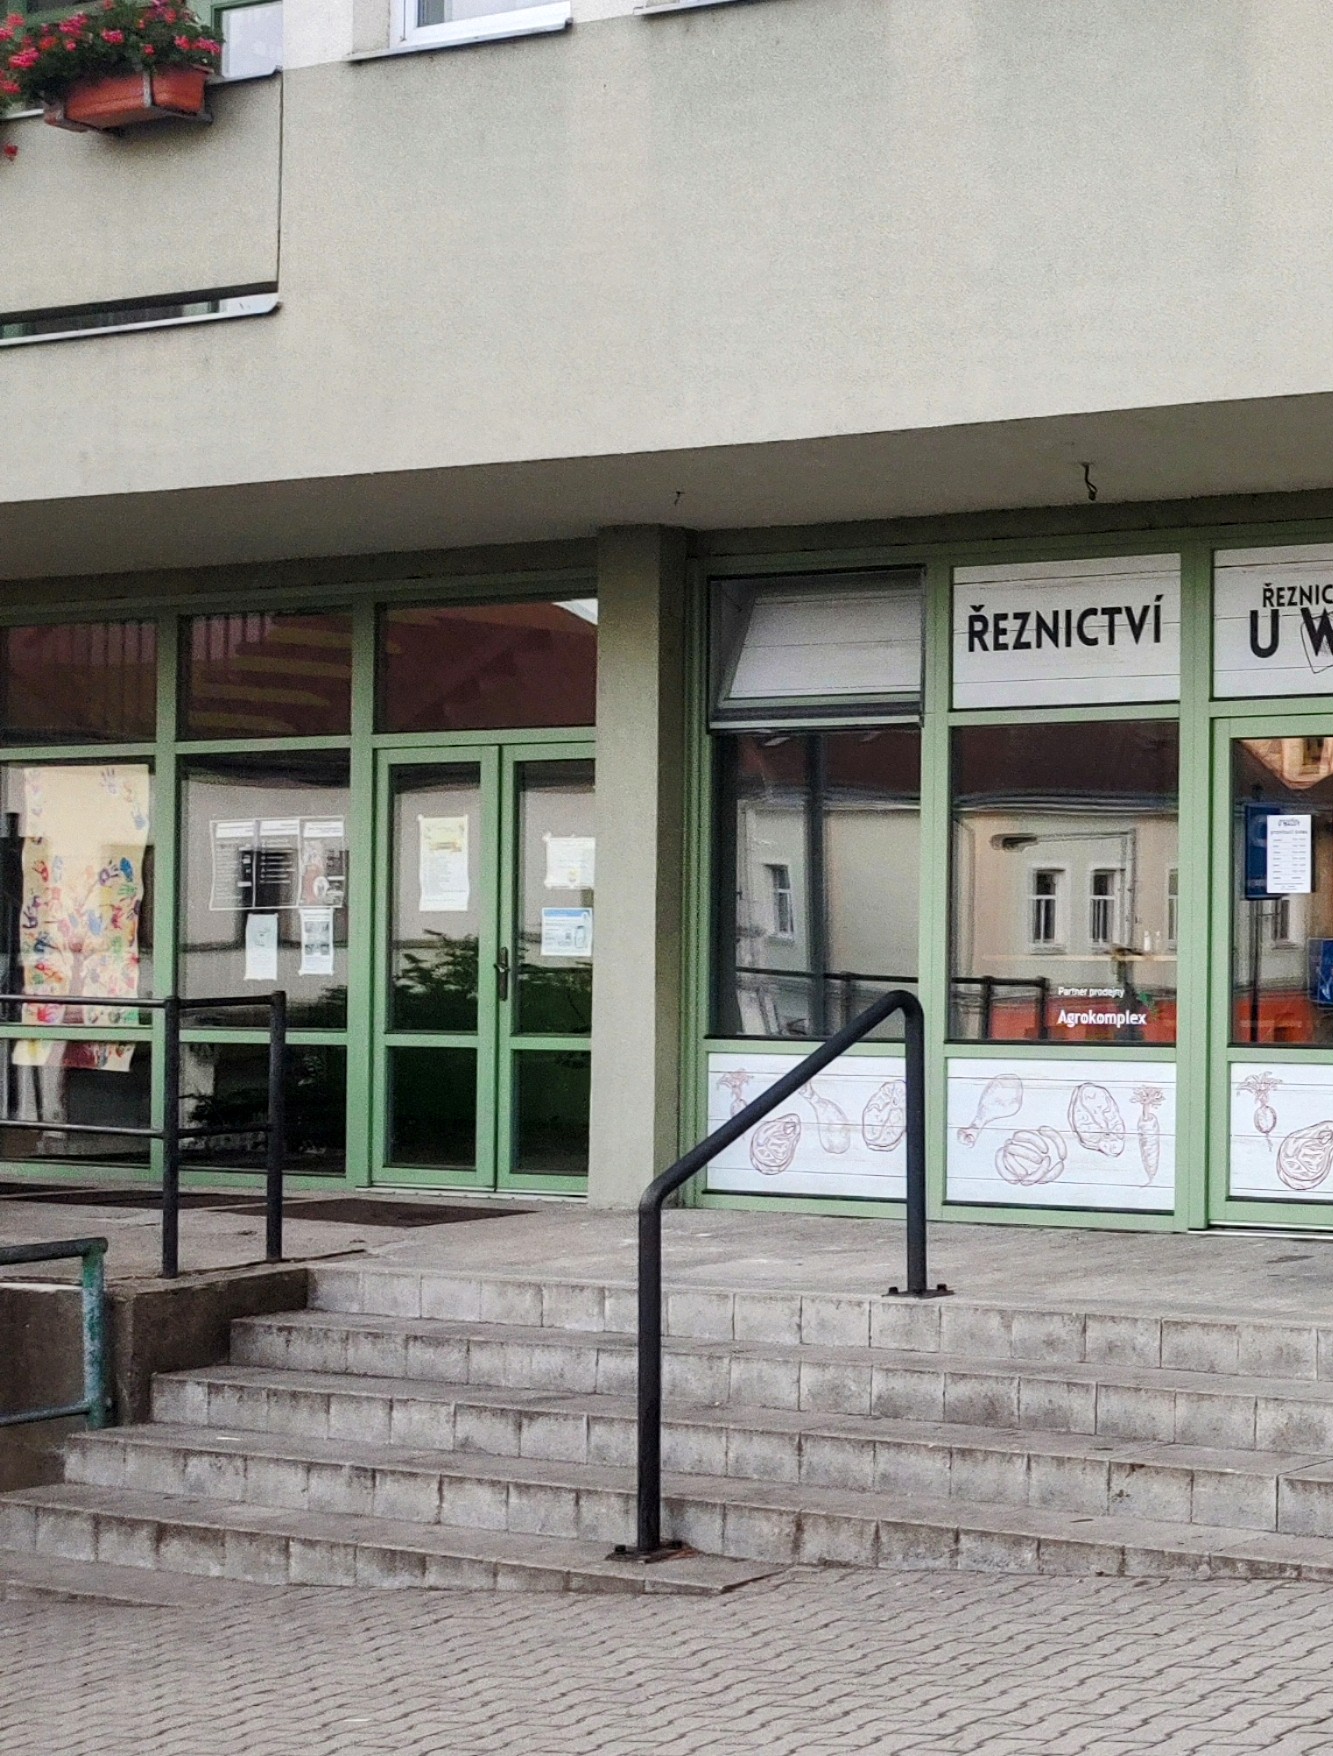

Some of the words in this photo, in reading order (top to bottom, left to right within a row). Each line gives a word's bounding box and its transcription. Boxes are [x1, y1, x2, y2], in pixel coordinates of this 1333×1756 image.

[968, 594, 1164, 652] ŘEZNICTVÍ
[1250, 609, 1279, 658] U
[1058, 987, 1087, 996] Partner
[1057, 1009, 1147, 1028] Agrokomplex
